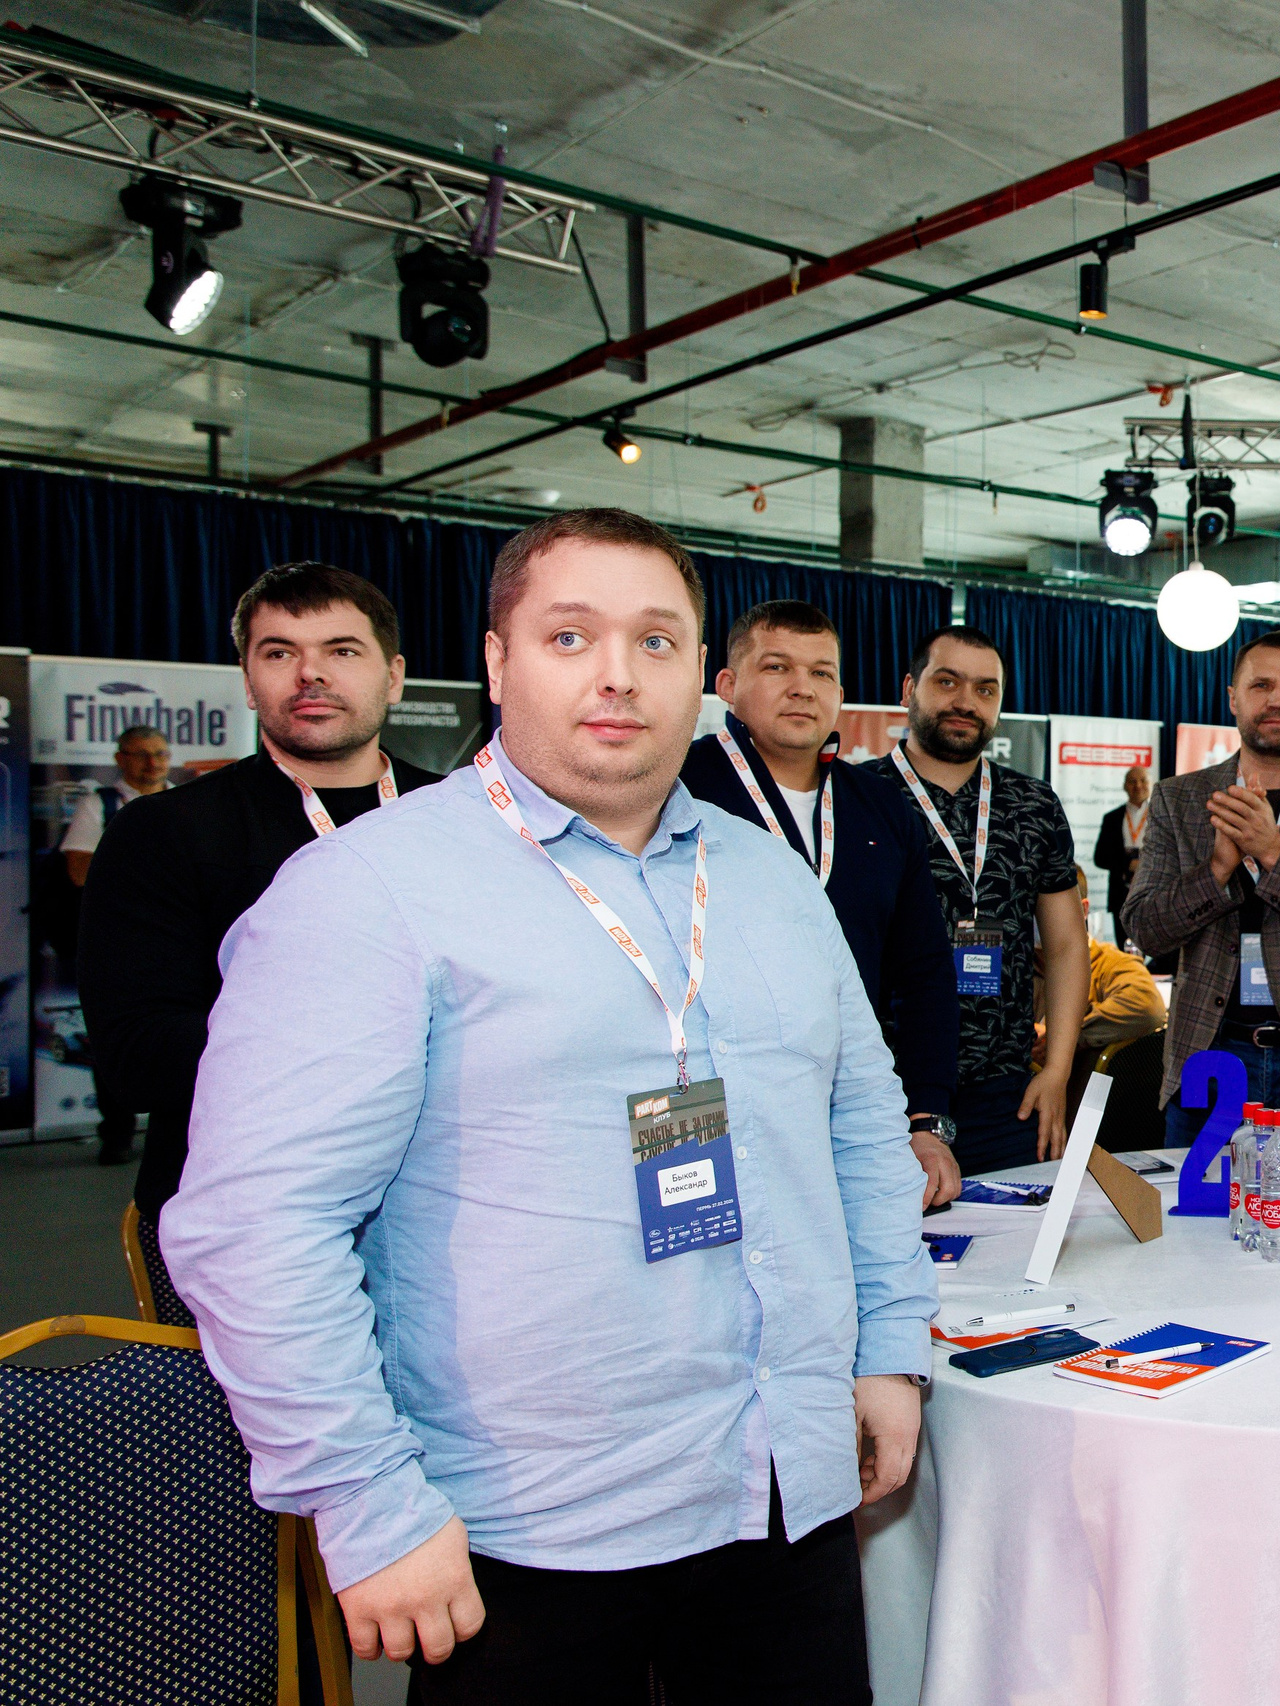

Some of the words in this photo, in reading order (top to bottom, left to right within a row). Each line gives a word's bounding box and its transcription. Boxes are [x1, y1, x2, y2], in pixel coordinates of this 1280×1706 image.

[65, 694, 227, 746] Finwhale
[1061, 745, 1150, 766] FEBEST
[578, 888, 599, 904] PART
[609, 927, 632, 944] KOM
[619, 940, 642, 957] PART
[635, 1100, 653, 1118] PART
[652, 1097, 669, 1114] KOM
[653, 1111, 671, 1124] КЛУБ
[638, 1123, 674, 1146] СЧАСТЬЕ
[679, 1120, 688, 1133] НЕ
[693, 1116, 702, 1129] ЗА
[1178, 1050, 1248, 1217] 2
[671, 1170, 698, 1182] Быков
[664, 1179, 708, 1195] Александр
